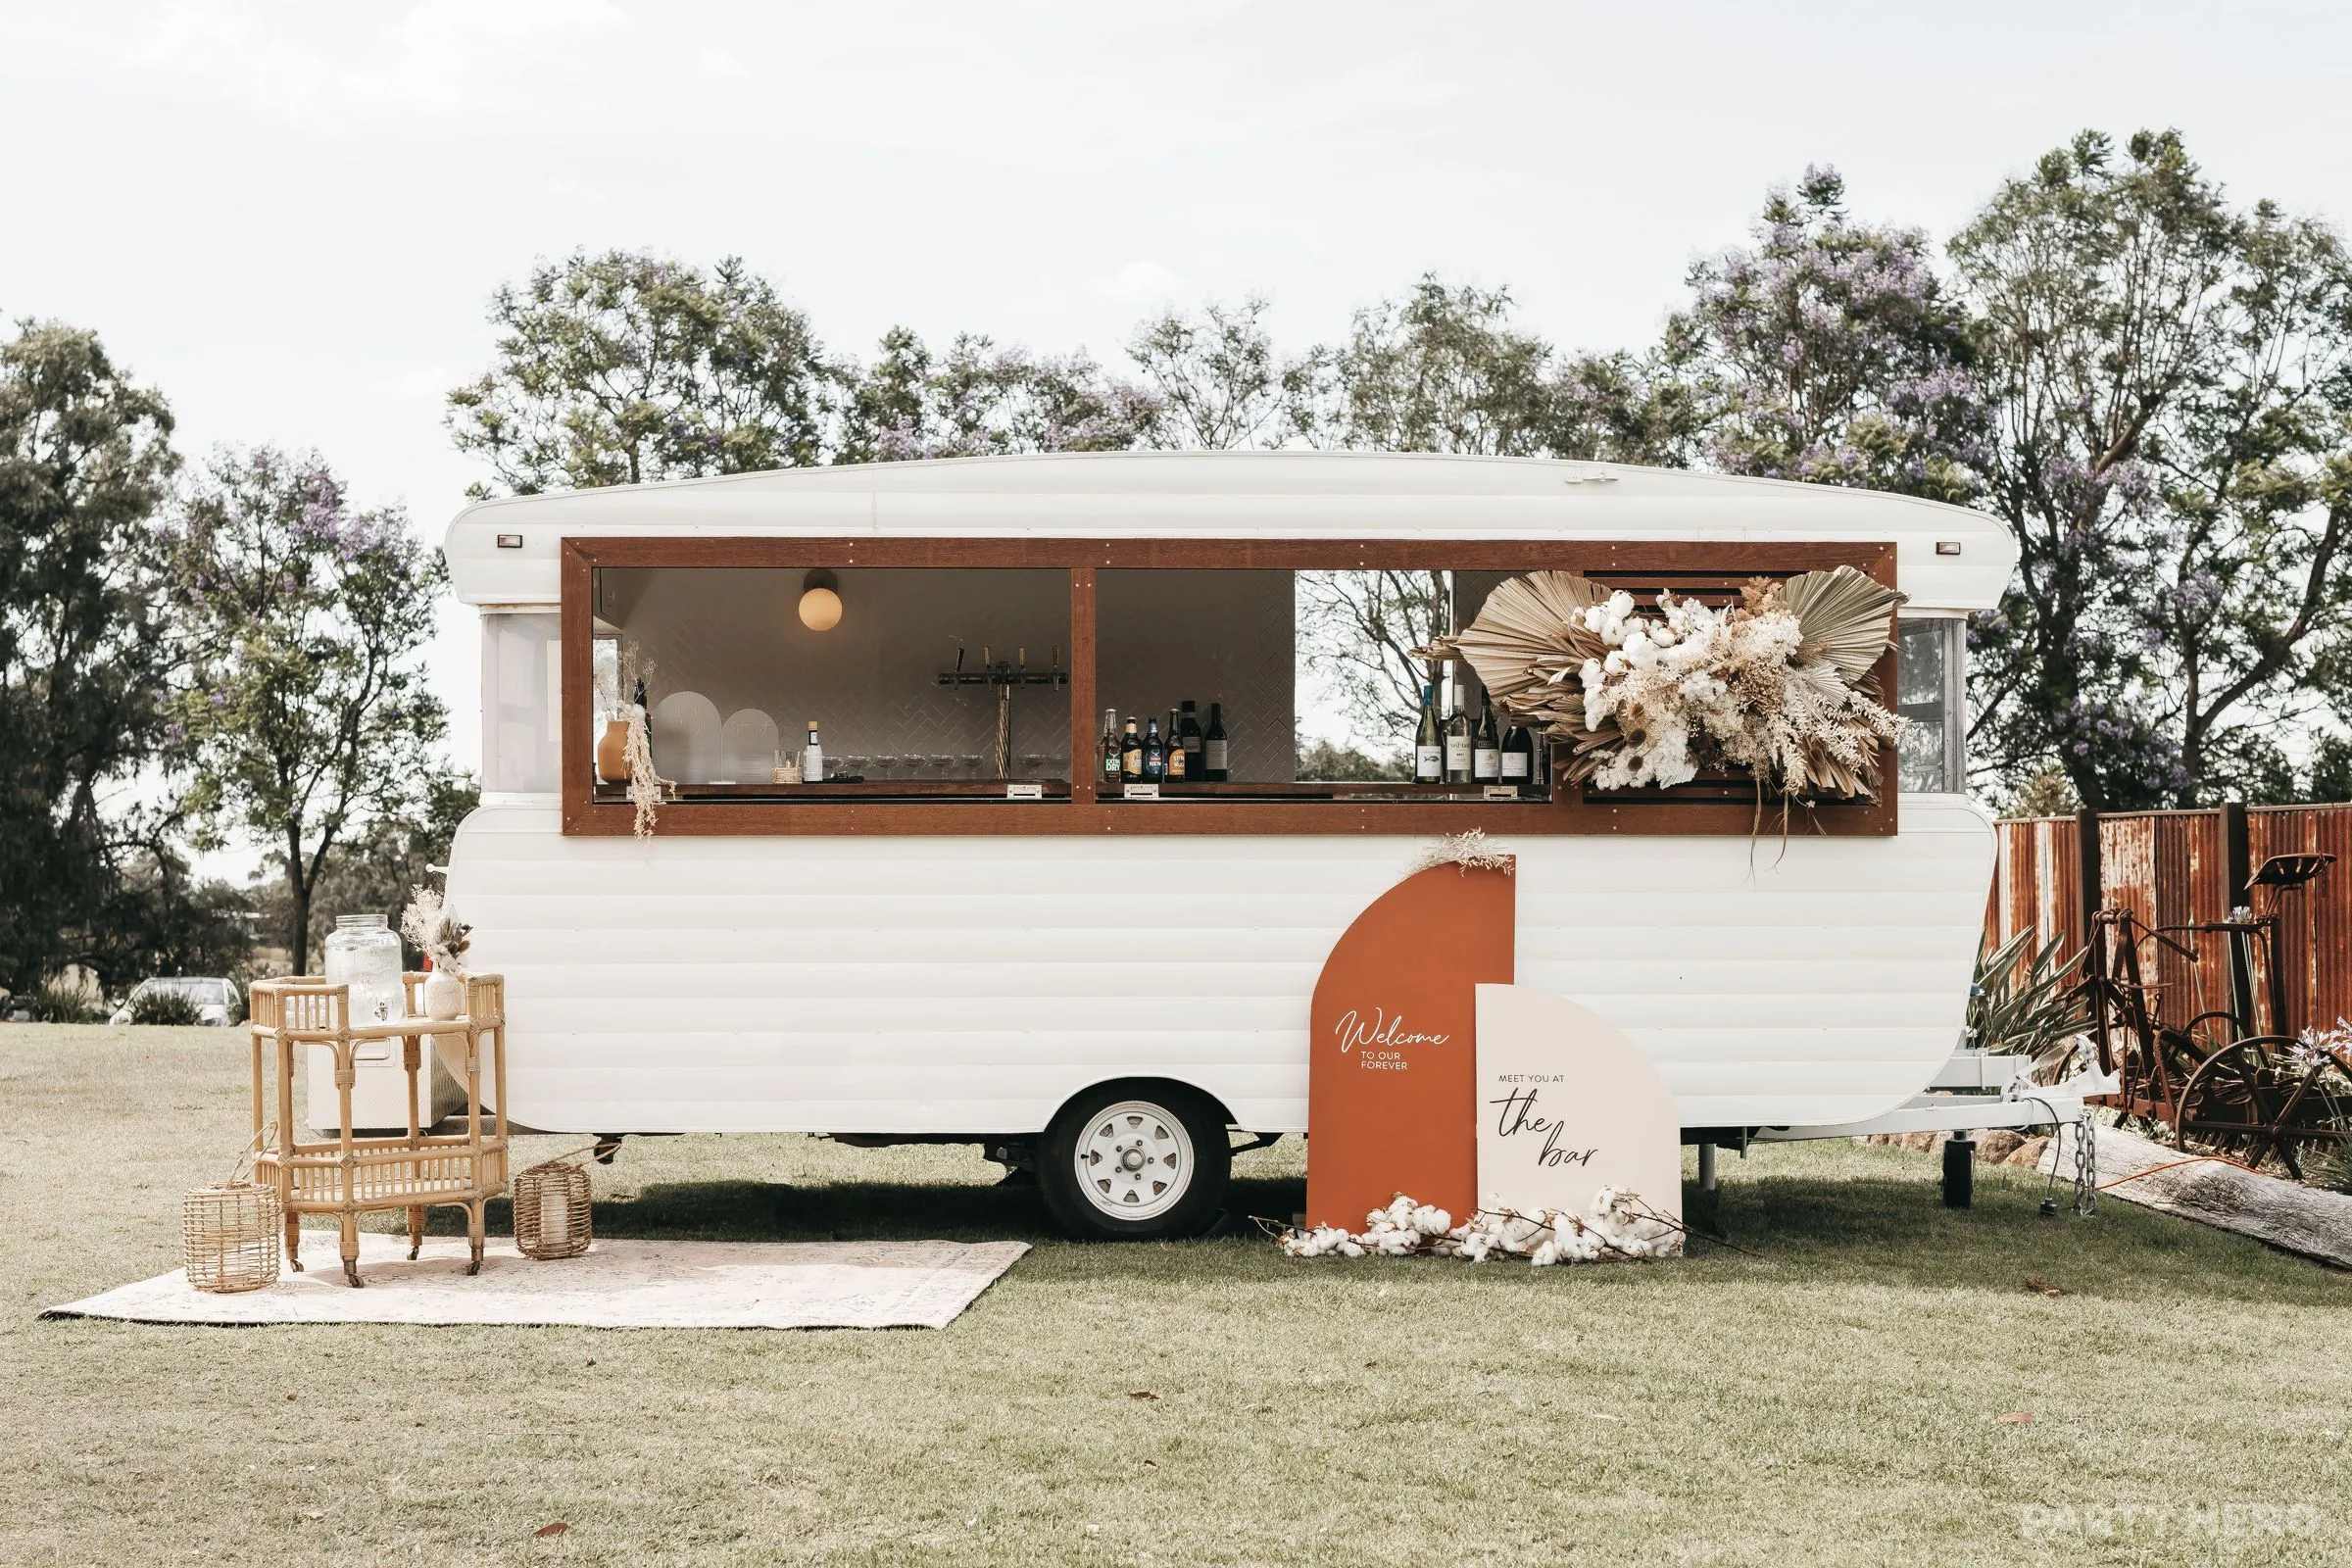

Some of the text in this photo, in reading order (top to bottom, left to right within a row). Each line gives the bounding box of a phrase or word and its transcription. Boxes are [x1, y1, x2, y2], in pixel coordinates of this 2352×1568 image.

[1335, 1006, 1450, 1054] Welcome
[1360, 1051, 1400, 1060] TO OUR
[1360, 1060, 1408, 1070] FOREVER
[1498, 1074, 1565, 1083] MEET YOU AT
[1489, 1087, 1553, 1137] the
[1538, 1120, 1598, 1167] bar
